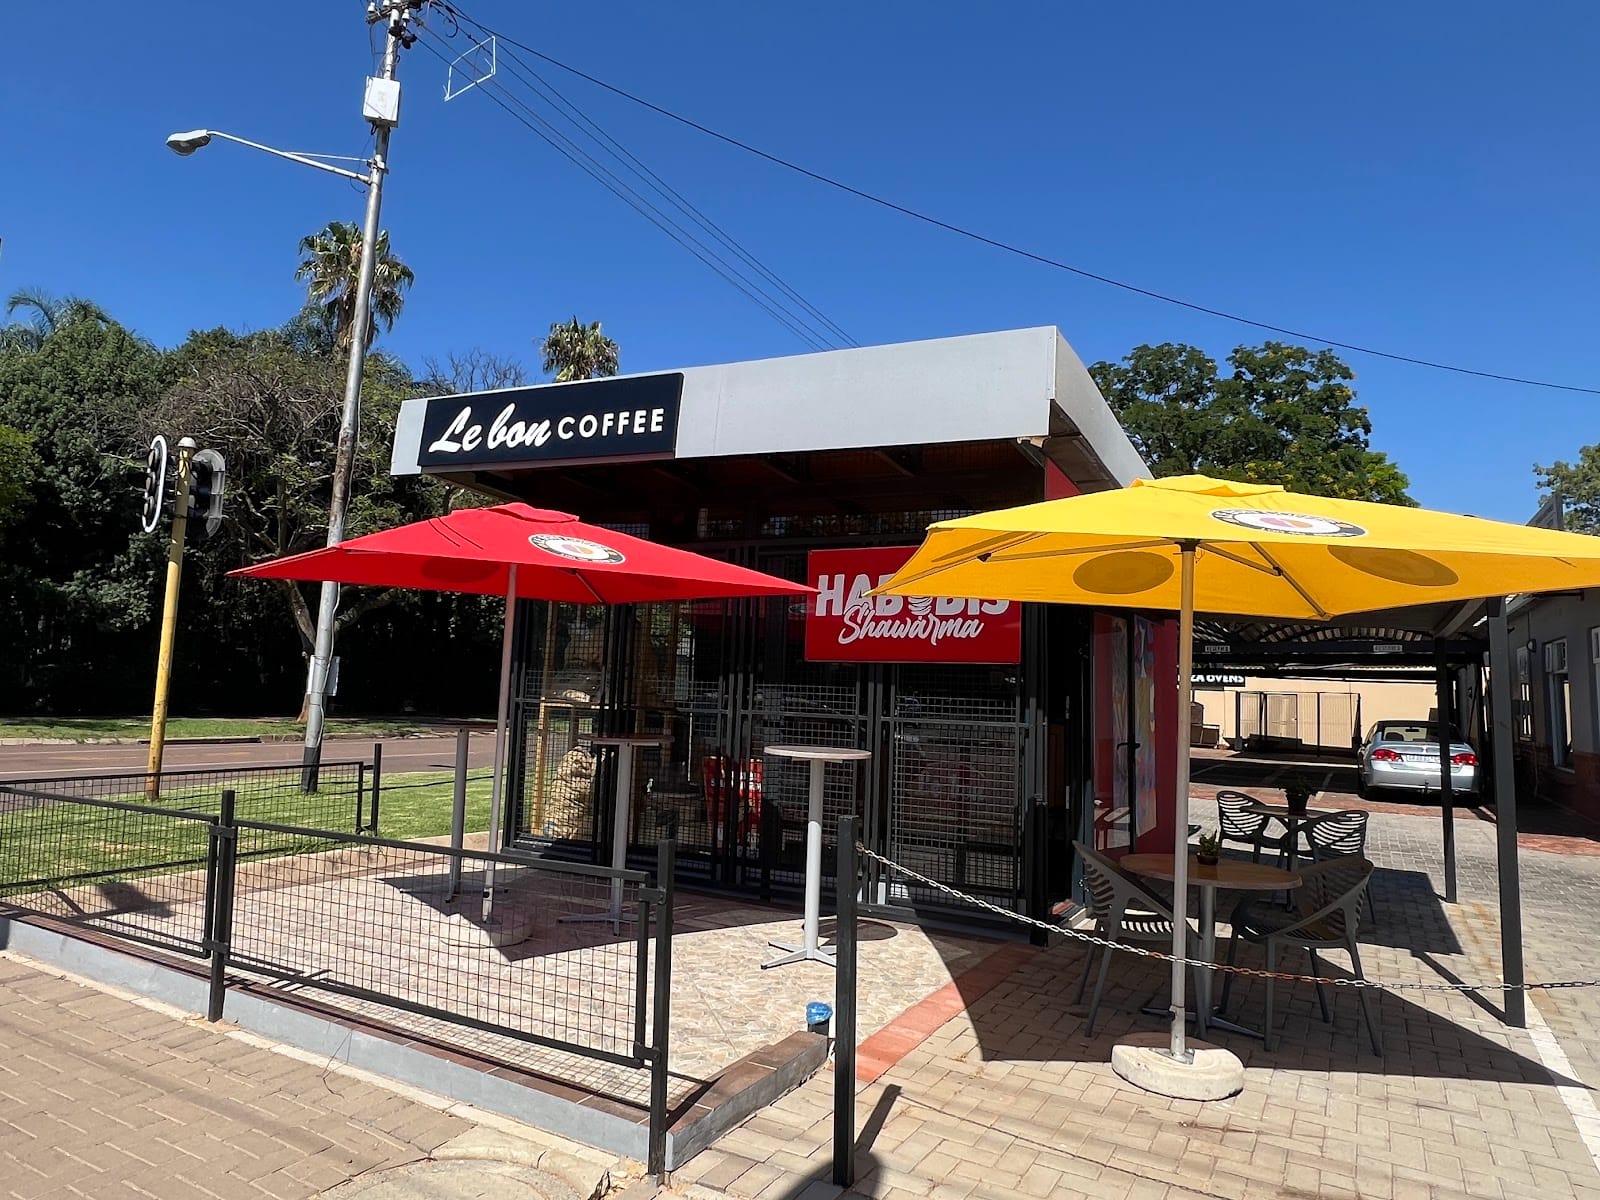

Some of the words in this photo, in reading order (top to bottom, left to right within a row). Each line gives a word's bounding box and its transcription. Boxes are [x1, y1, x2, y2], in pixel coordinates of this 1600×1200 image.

[428, 406, 483, 453] Le
[487, 402, 552, 450] bon
[557, 408, 665, 440] COFFEE
[838, 602, 985, 646] Shawarma
[1206, 674, 1245, 683] OVENS
